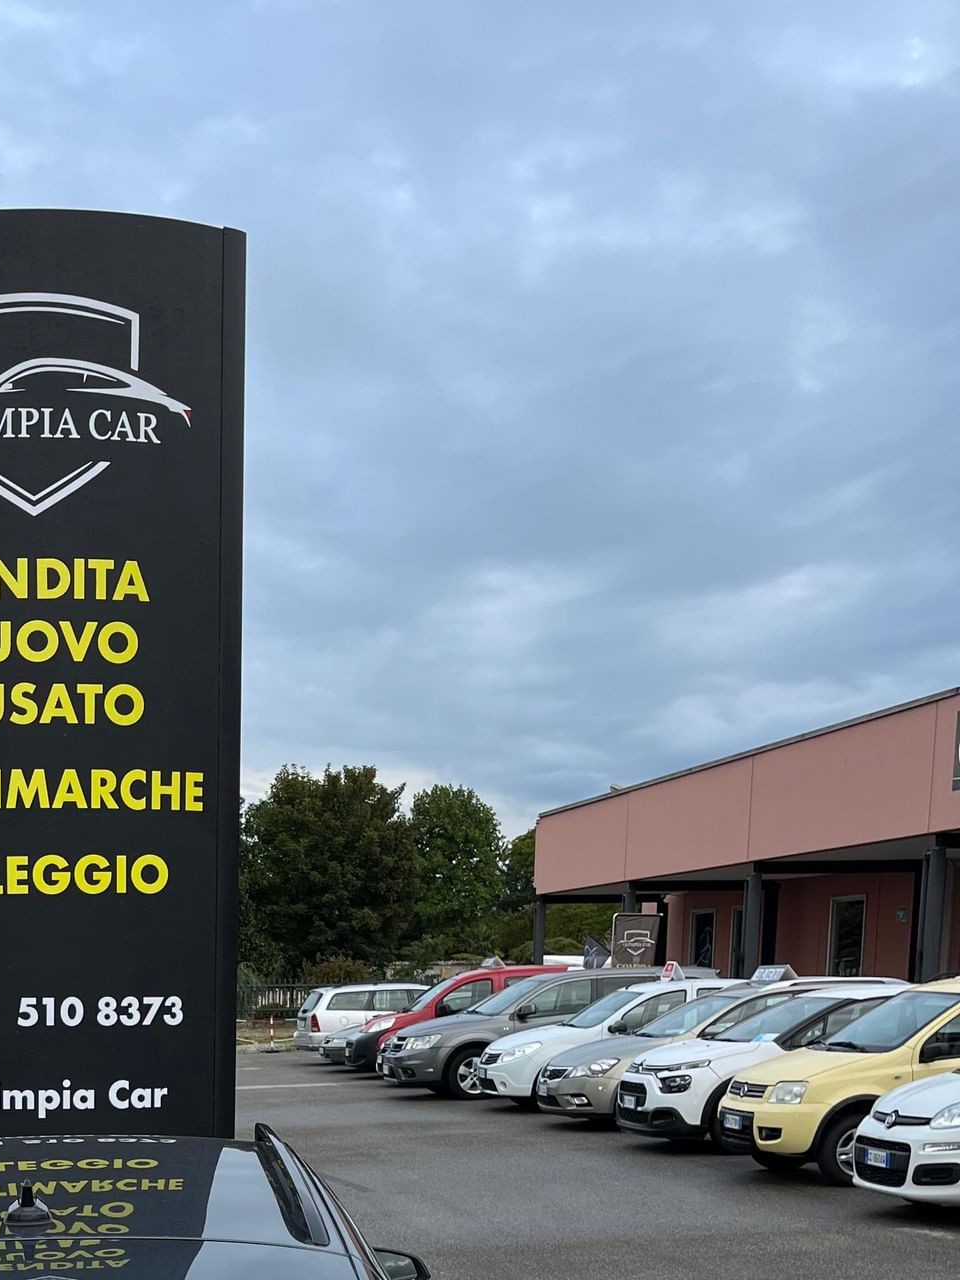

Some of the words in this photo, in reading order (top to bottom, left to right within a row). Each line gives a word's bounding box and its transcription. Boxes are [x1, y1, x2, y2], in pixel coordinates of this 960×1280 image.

[88, 408, 161, 444] CAR
[17, 996, 84, 1027] 510
[96, 995, 184, 1026] 8373
[108, 1079, 168, 1109] Car
